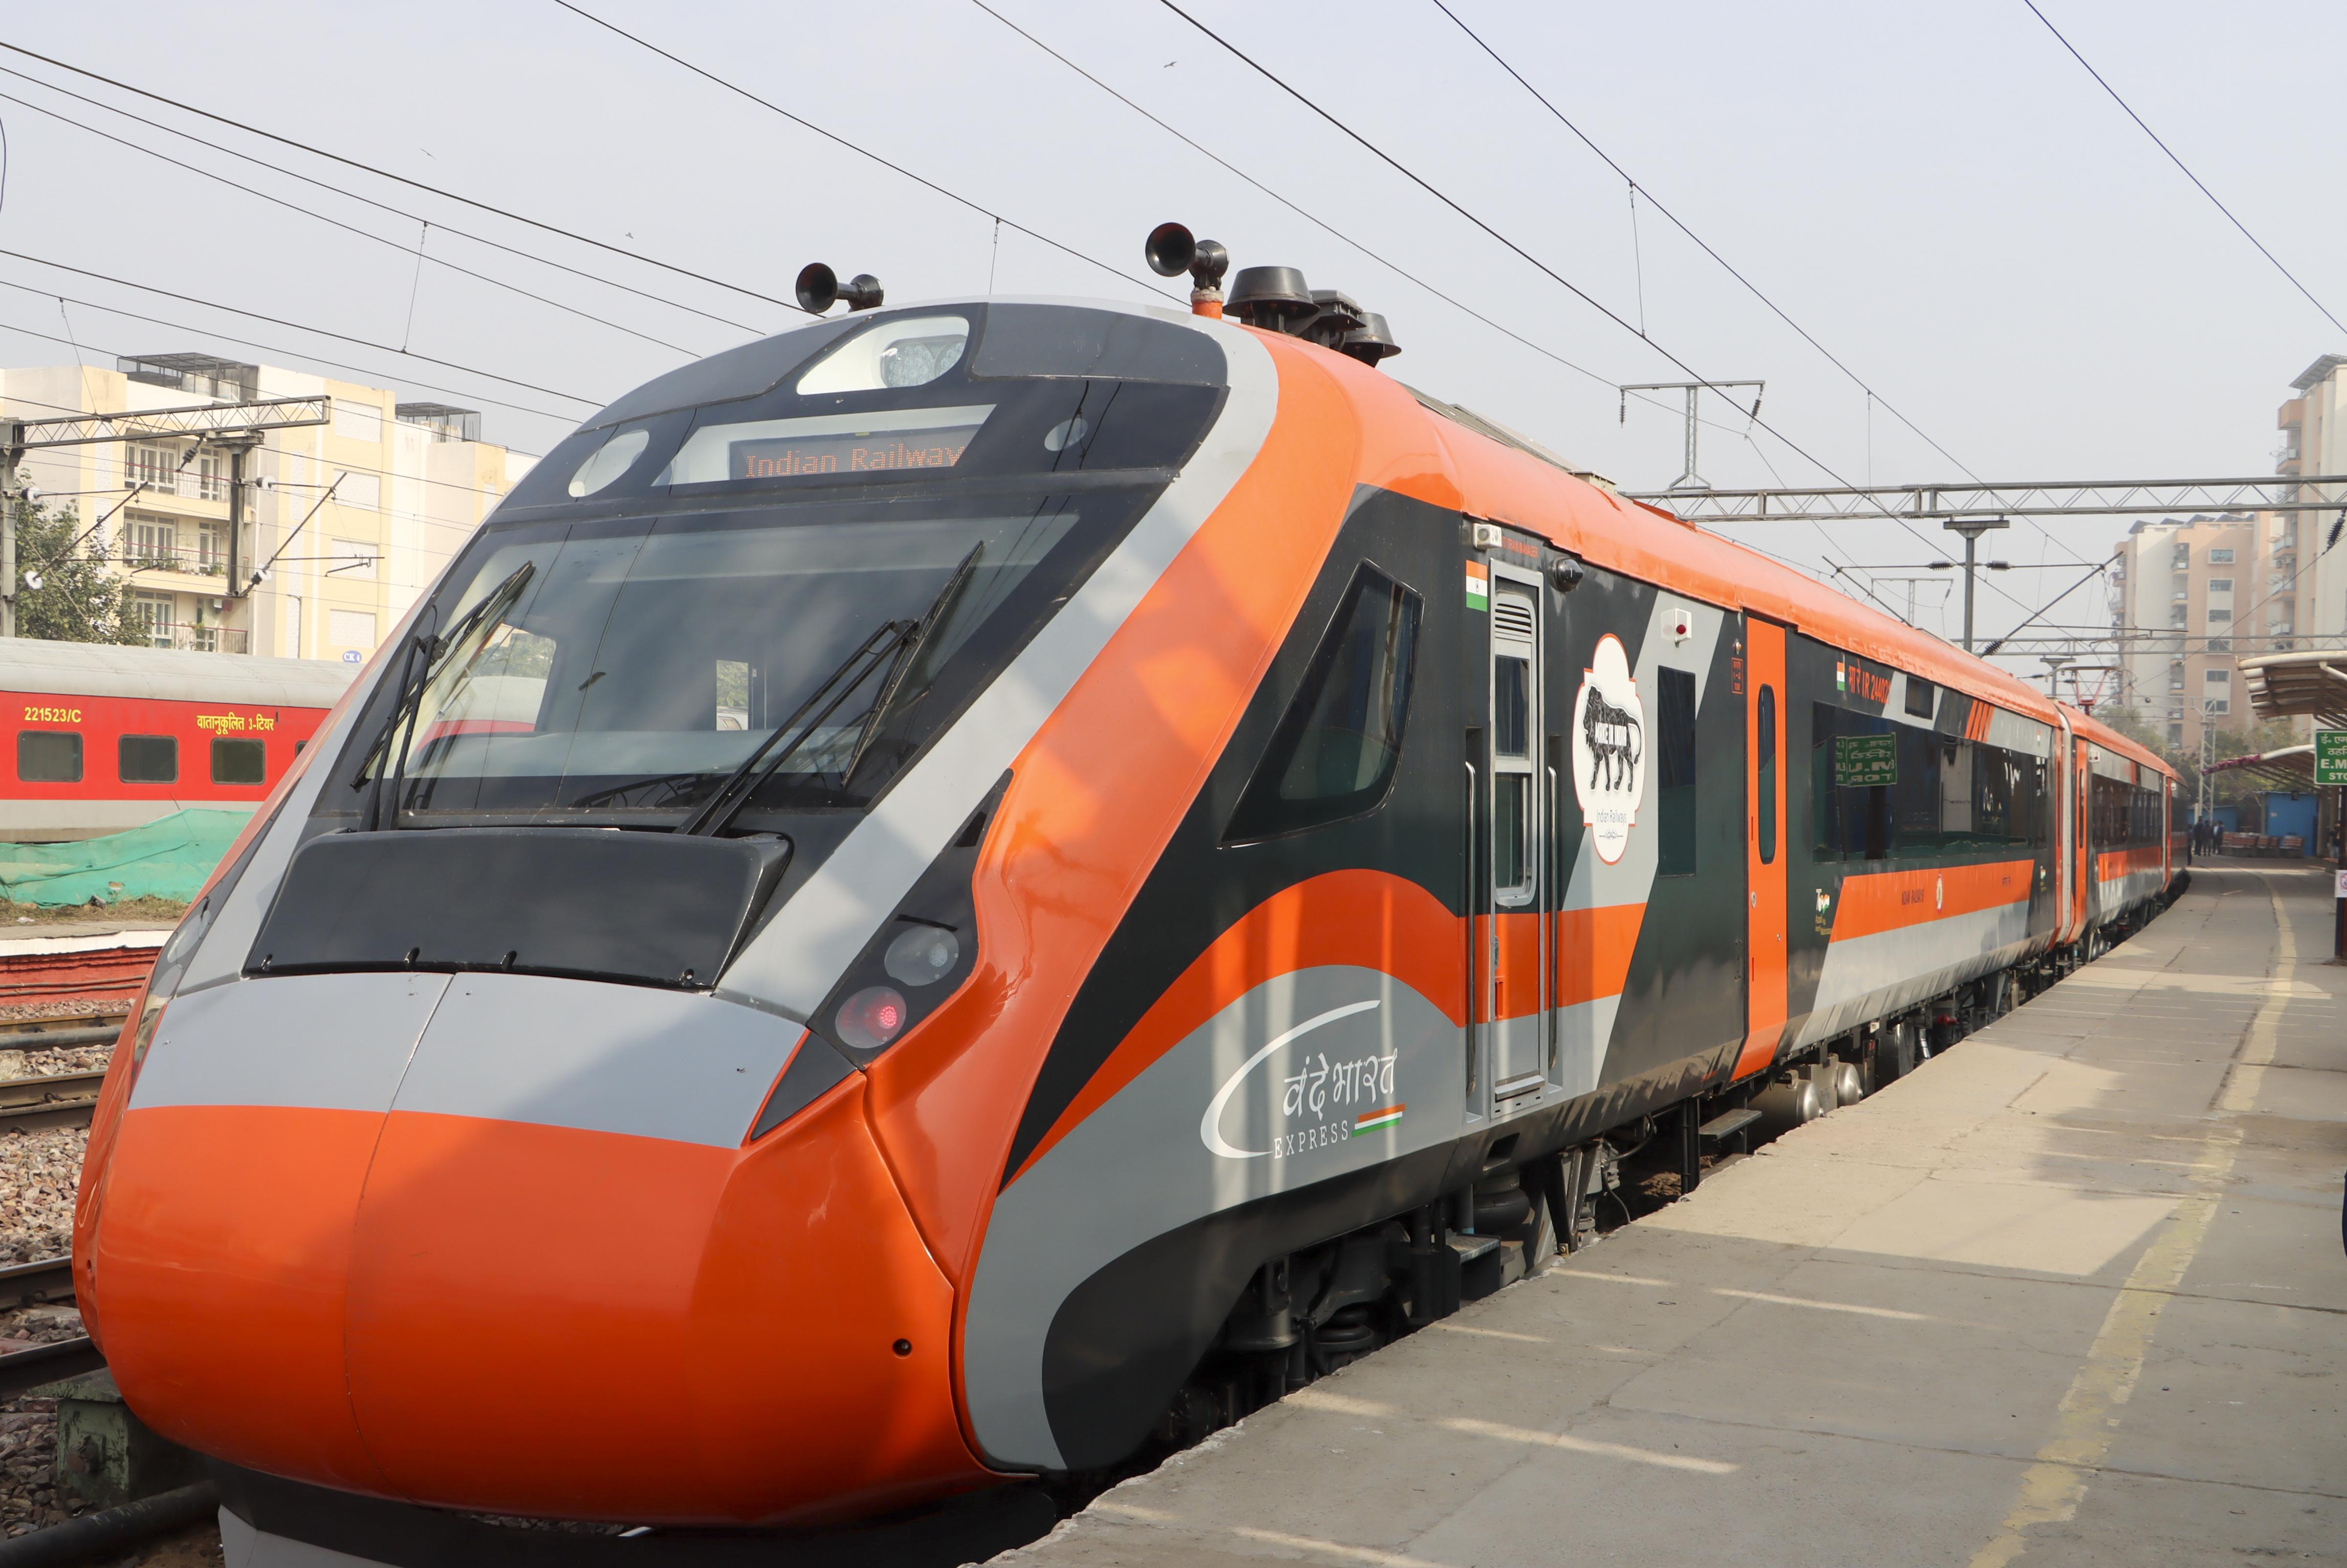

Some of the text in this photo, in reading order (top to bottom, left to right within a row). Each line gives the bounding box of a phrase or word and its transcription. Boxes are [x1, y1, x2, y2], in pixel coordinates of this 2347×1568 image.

[746, 442, 966, 478] Indian Railway
[344, 653, 355, 661] CK
[24, 707, 82, 723] 221523/C
[197, 711, 245, 735] वातानुकूलित
[1595, 722, 1609, 744] MAKE
[1614, 725, 1627, 747] INDIA
[1283, 1047, 1398, 1121] वंदे भारत
[1274, 1120, 1349, 1159] EXPRESS
